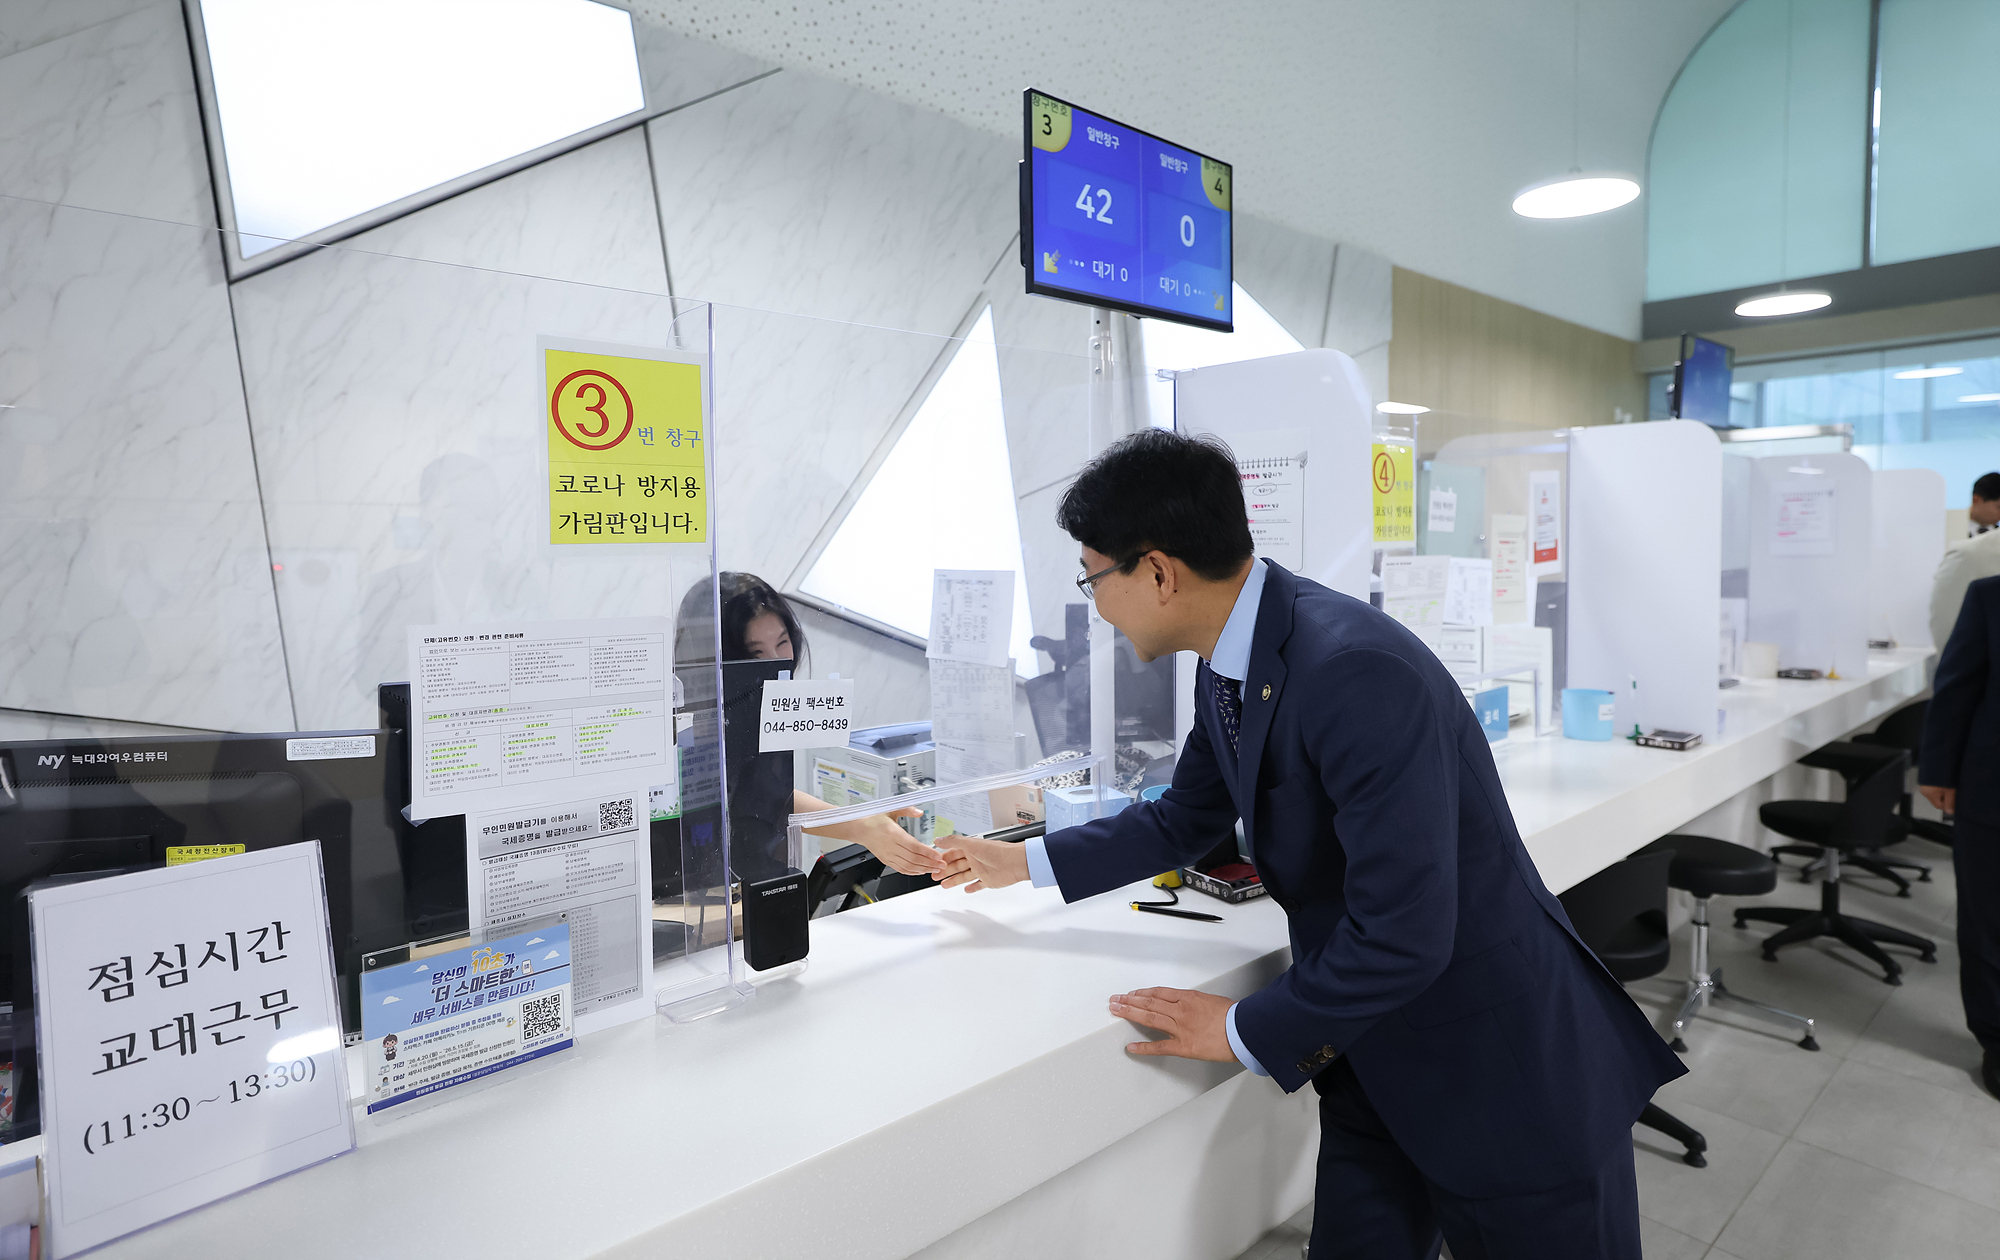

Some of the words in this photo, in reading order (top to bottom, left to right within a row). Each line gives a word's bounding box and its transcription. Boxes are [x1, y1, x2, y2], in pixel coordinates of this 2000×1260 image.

[1042, 114, 1052, 136] 3
[1087, 126, 1120, 149] 일반창구
[1160, 153, 1188, 174] 일반창구
[1214, 178, 1223, 195] 4
[1075, 184, 1113, 224] 42
[1180, 215, 1195, 247] 0
[1093, 261, 1114, 281] 대기
[1121, 268, 1128, 282] 0
[1160, 277, 1178, 296] 대기
[1184, 283, 1190, 297] 0
[638, 427, 654, 446] 번
[666, 428, 702, 448] 창구
[556, 474, 625, 497] 코로나
[638, 475, 700, 499] 방지용
[1375, 506, 1393, 517] 코로나
[559, 512, 698, 535] 가림판입니다.
[772, 698, 800, 711] 민원실
[806, 696, 844, 710] 팩스번호
[764, 719, 848, 733] 044-850-8439
[72, 752, 167, 764] 늑대와여우컴퓨터
[483, 818, 547, 835] 무인민원발급기를
[551, 813, 578, 823] 이용해서
[502, 832, 540, 845] 국세증명을
[88, 920, 291, 1003] 점심시간
[431, 966, 467, 985] 당신의
[472, 952, 516, 974] 10초가
[411, 1007, 436, 1025] 세무
[438, 993, 485, 1017] 서비스를
[488, 979, 536, 1003] 만듭니다!
[92, 987, 299, 1076] 교대근무
[393, 1061, 404, 1069] 기간
[393, 1073, 405, 1081] 대상
